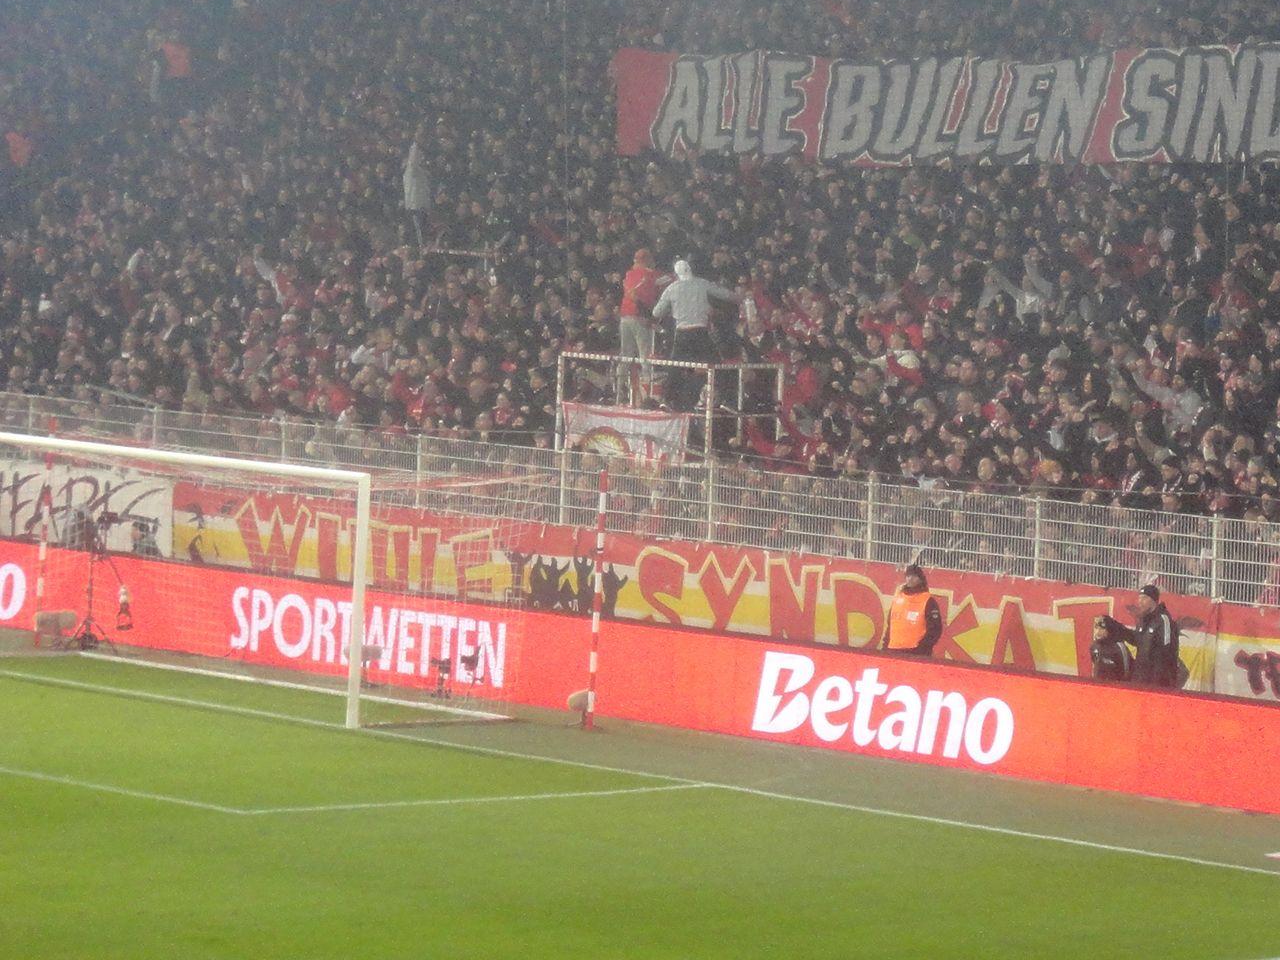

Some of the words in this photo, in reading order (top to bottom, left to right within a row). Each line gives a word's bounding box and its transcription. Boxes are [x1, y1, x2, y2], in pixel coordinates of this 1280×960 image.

[656, 52, 811, 157] ALLE
[824, 53, 1109, 161] BULLEN
[634, 545, 1115, 677] SYNDKAT
[751, 651, 1015, 766] Betano
